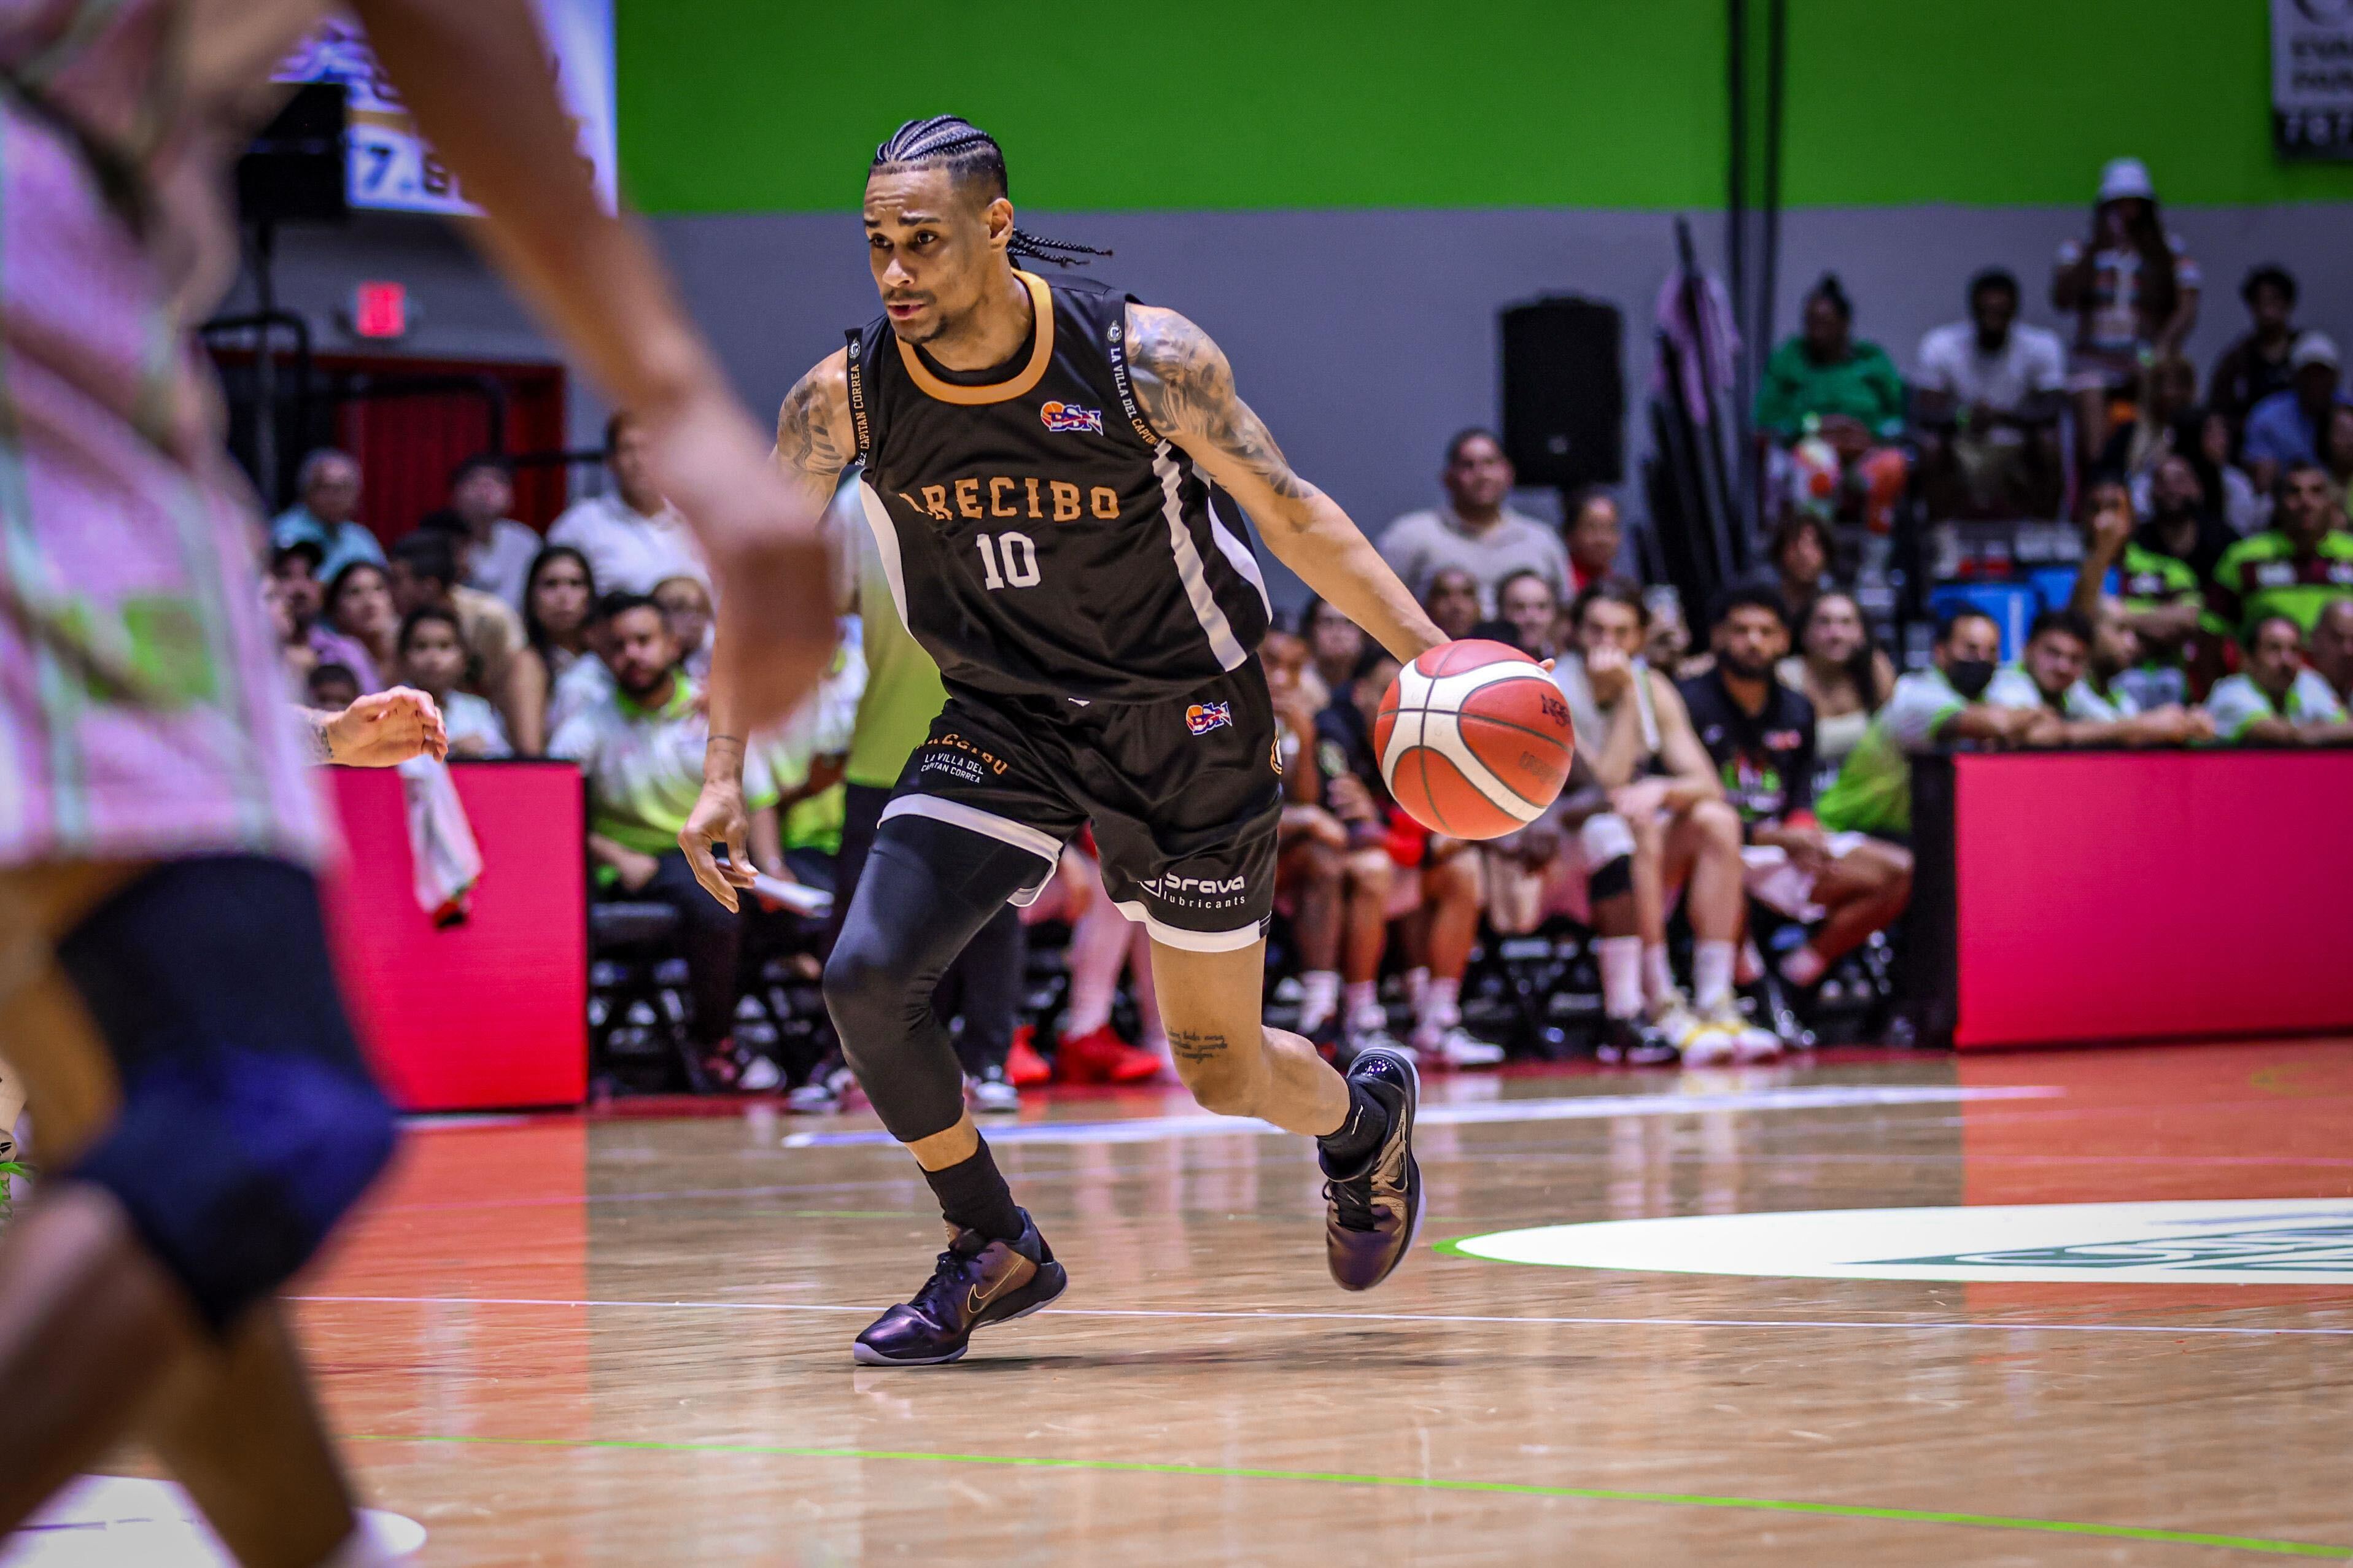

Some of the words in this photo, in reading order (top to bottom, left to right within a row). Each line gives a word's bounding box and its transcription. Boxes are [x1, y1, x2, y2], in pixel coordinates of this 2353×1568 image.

[1111, 347, 1122, 363] LA
[851, 364, 864, 409] CORREA
[1113, 365, 1129, 396] VILLA
[1122, 399, 1138, 419] DEL
[856, 412, 869, 449] CAPITAN
[976, 531, 1041, 590] 10
[921, 762, 949, 773] CAPITAN
[950, 767, 980, 783] CORREA
[925, 754, 935, 763] LA
[937, 753, 964, 767] VILLA
[966, 760, 983, 775] DEL
[1164, 890, 1245, 909] lubricants
